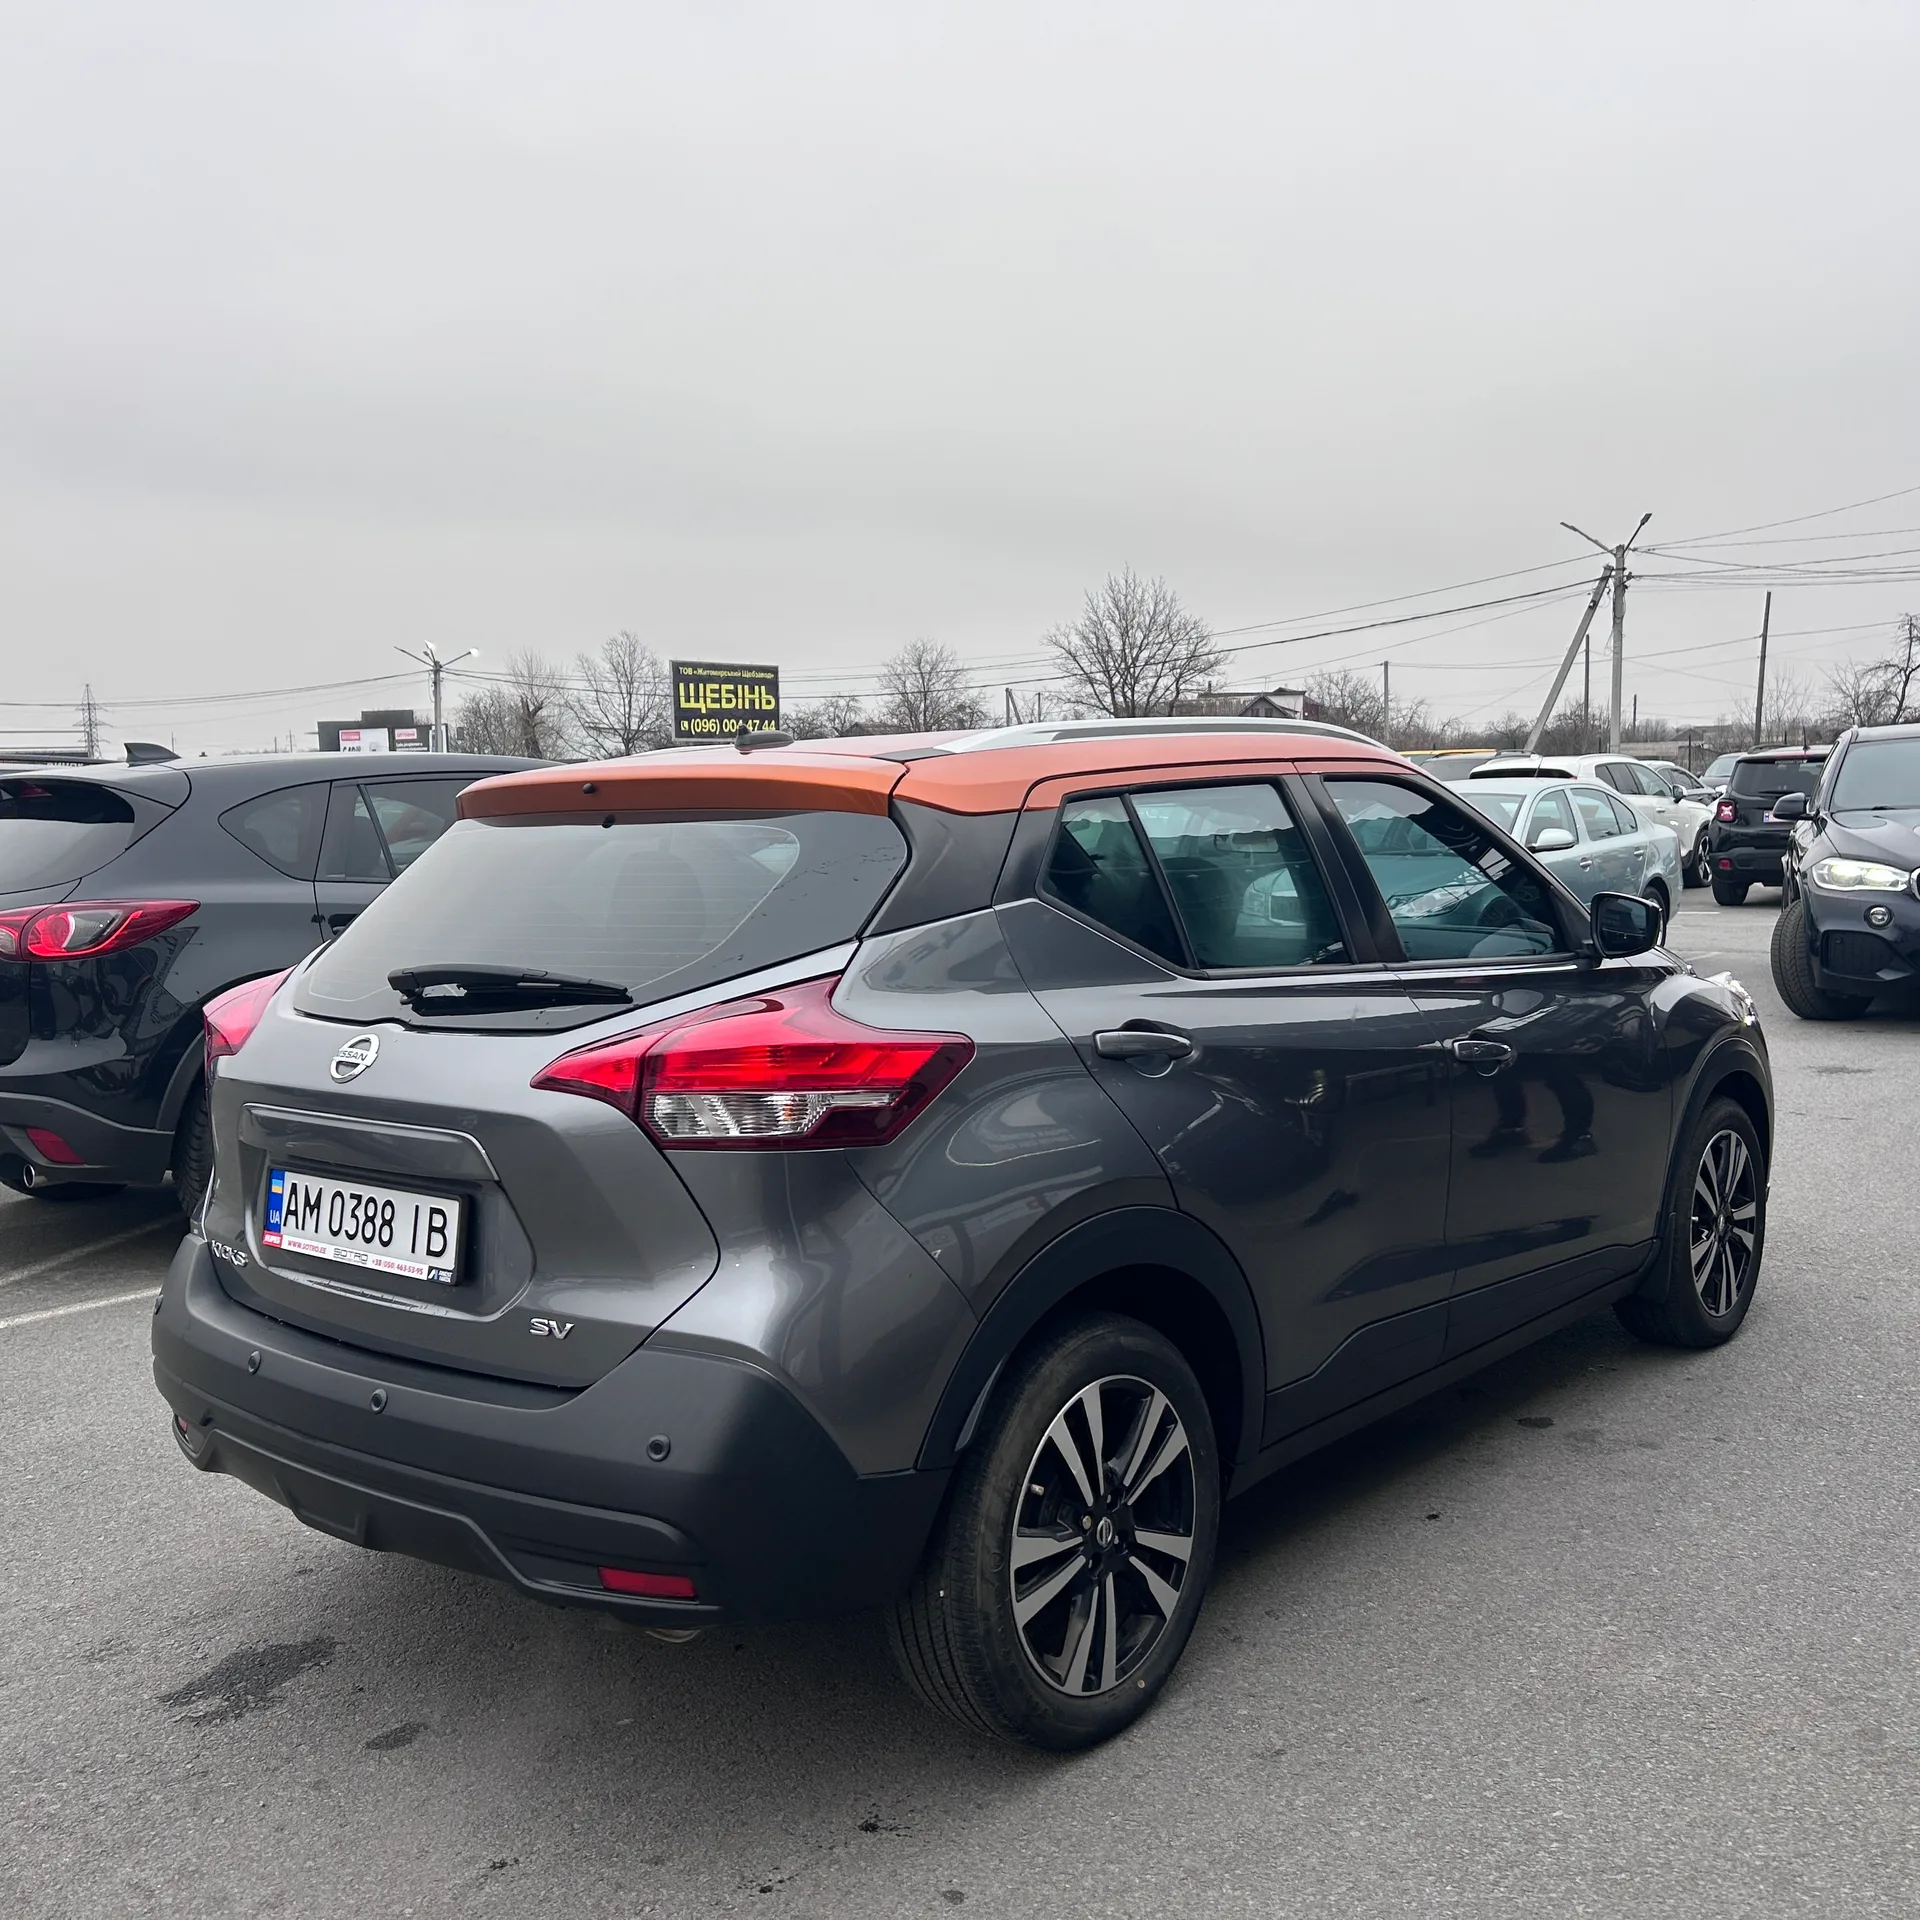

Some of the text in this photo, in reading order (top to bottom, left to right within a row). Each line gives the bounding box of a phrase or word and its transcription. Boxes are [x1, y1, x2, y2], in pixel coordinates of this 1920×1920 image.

[679, 666, 692, 675] ТОВ
[678, 682, 776, 714] ЩЕБІНЬ
[690, 718, 720, 735] (096)
[269, 1209, 281, 1225] UA
[283, 1182, 448, 1258] AM 0388 IB
[333, 1247, 369, 1262] SOTRO
[371, 1257, 382, 1266] +38
[529, 1317, 575, 1340] SV
